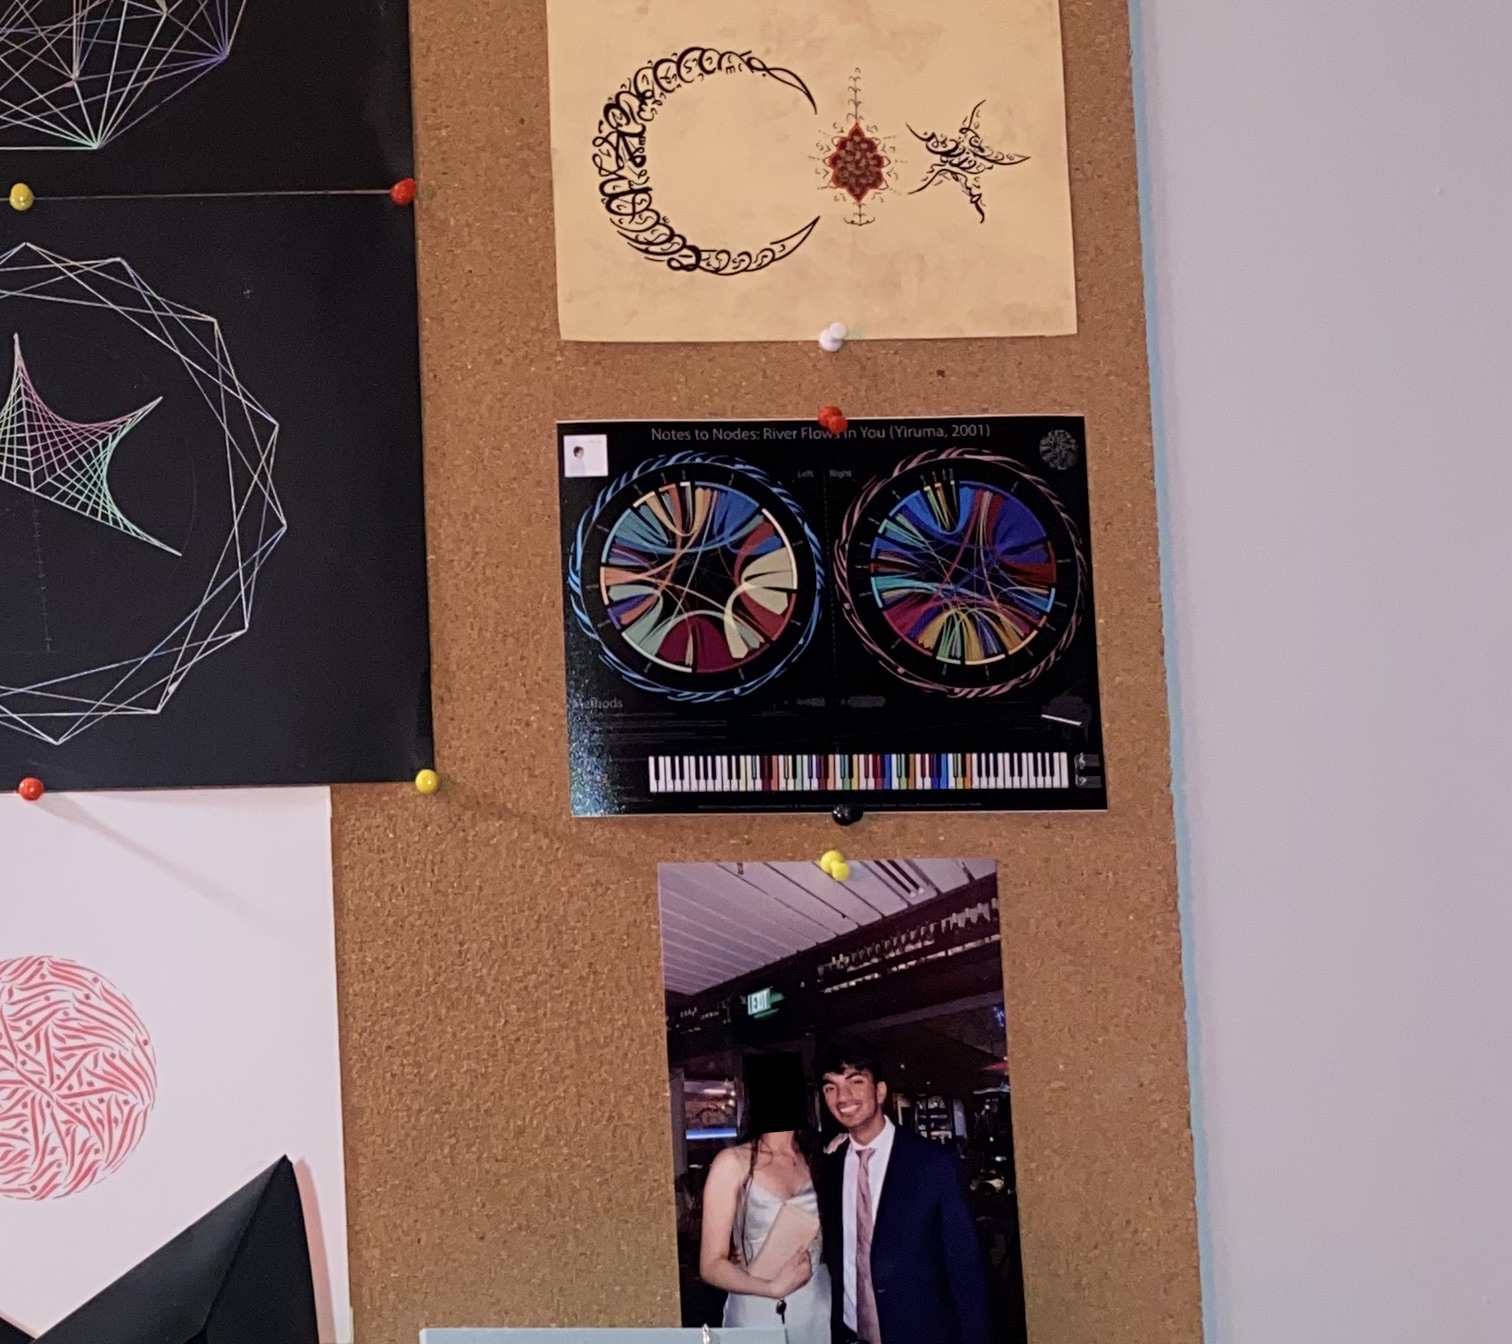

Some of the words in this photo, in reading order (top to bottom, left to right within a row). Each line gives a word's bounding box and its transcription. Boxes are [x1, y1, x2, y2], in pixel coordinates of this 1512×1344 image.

[651, 428, 692, 441] Notes
[694, 429, 709, 441] to
[713, 428, 760, 441] Nodes:
[763, 427, 798, 440] River
[859, 425, 886, 439] You
[889, 424, 948, 440] (Yiruma,
[951, 423, 991, 439] 2001)
